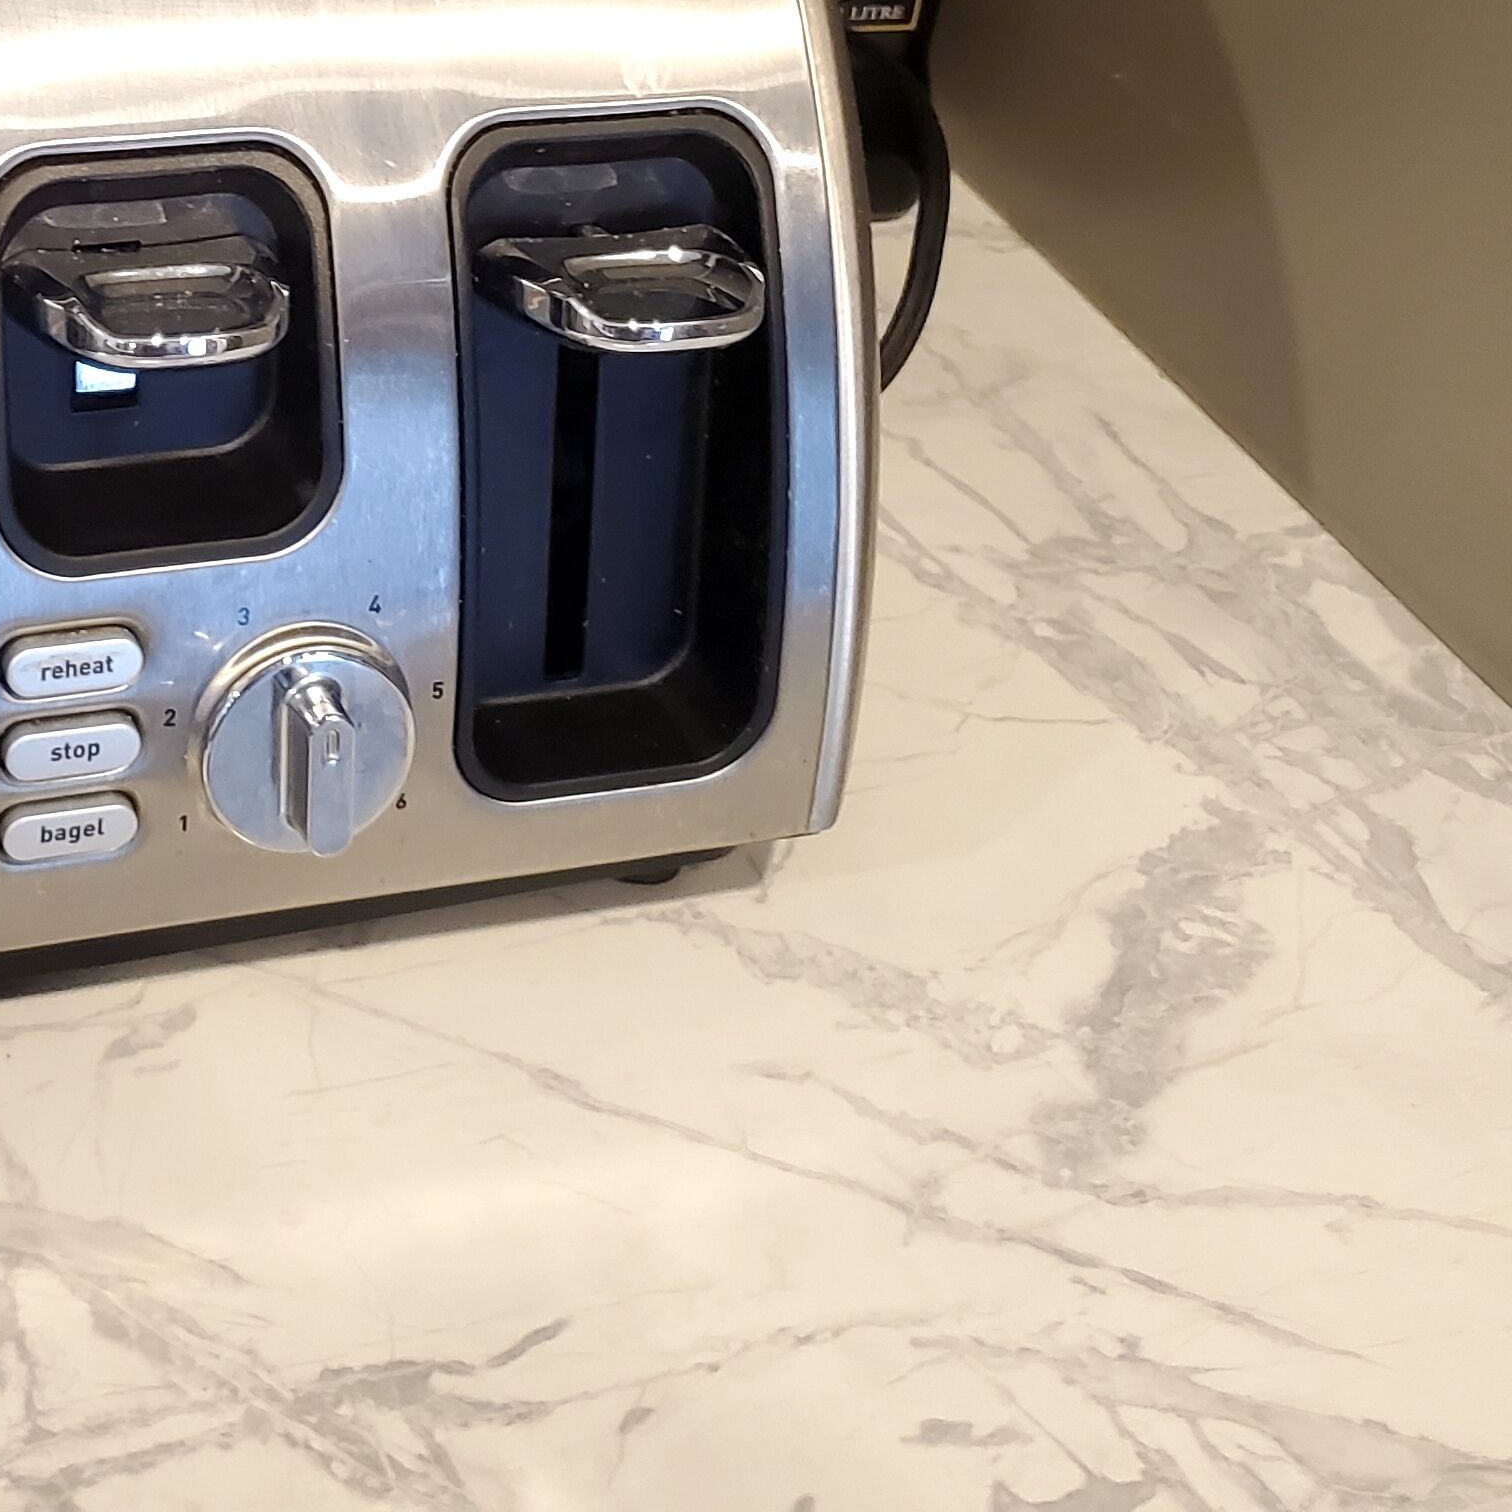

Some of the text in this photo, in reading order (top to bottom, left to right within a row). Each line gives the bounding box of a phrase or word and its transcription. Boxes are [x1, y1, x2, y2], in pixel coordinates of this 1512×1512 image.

[850, 5, 906, 20] LITRE
[368, 595, 382, 614] 4
[237, 607, 251, 626] 3
[40, 655, 114, 681] reheat
[432, 681, 444, 700] 5
[163, 709, 176, 727] 2
[50, 741, 101, 763] stop
[396, 793, 407, 809] 6
[40, 819, 105, 846] bagel
[179, 815, 188, 831] 1
